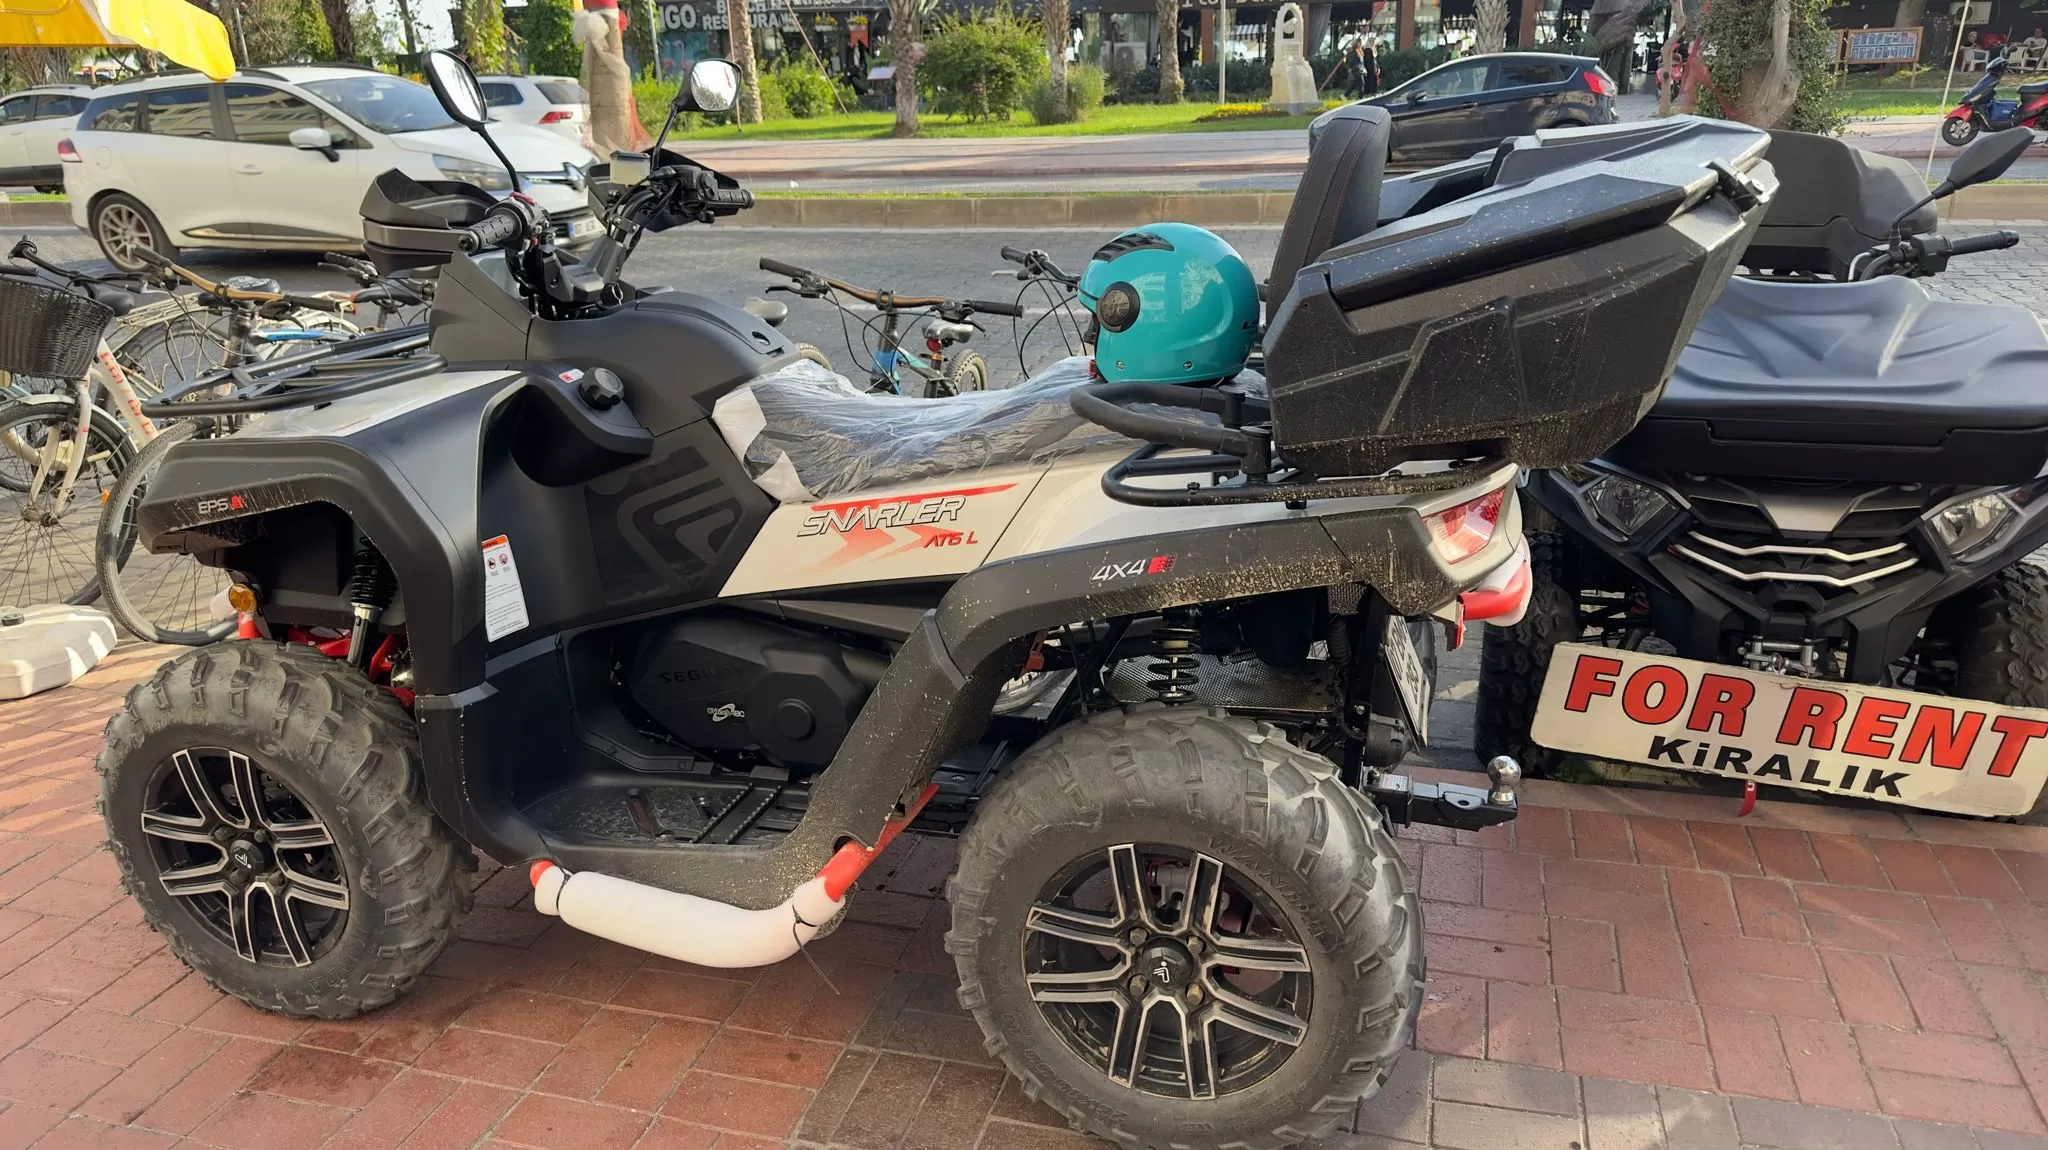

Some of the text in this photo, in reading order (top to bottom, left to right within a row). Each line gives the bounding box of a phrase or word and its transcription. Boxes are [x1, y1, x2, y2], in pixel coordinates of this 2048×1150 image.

[198, 497, 229, 514] EPS
[797, 496, 966, 537] SNARLER
[966, 531, 979, 545] L
[1564, 654, 2048, 777] FOR RENT
